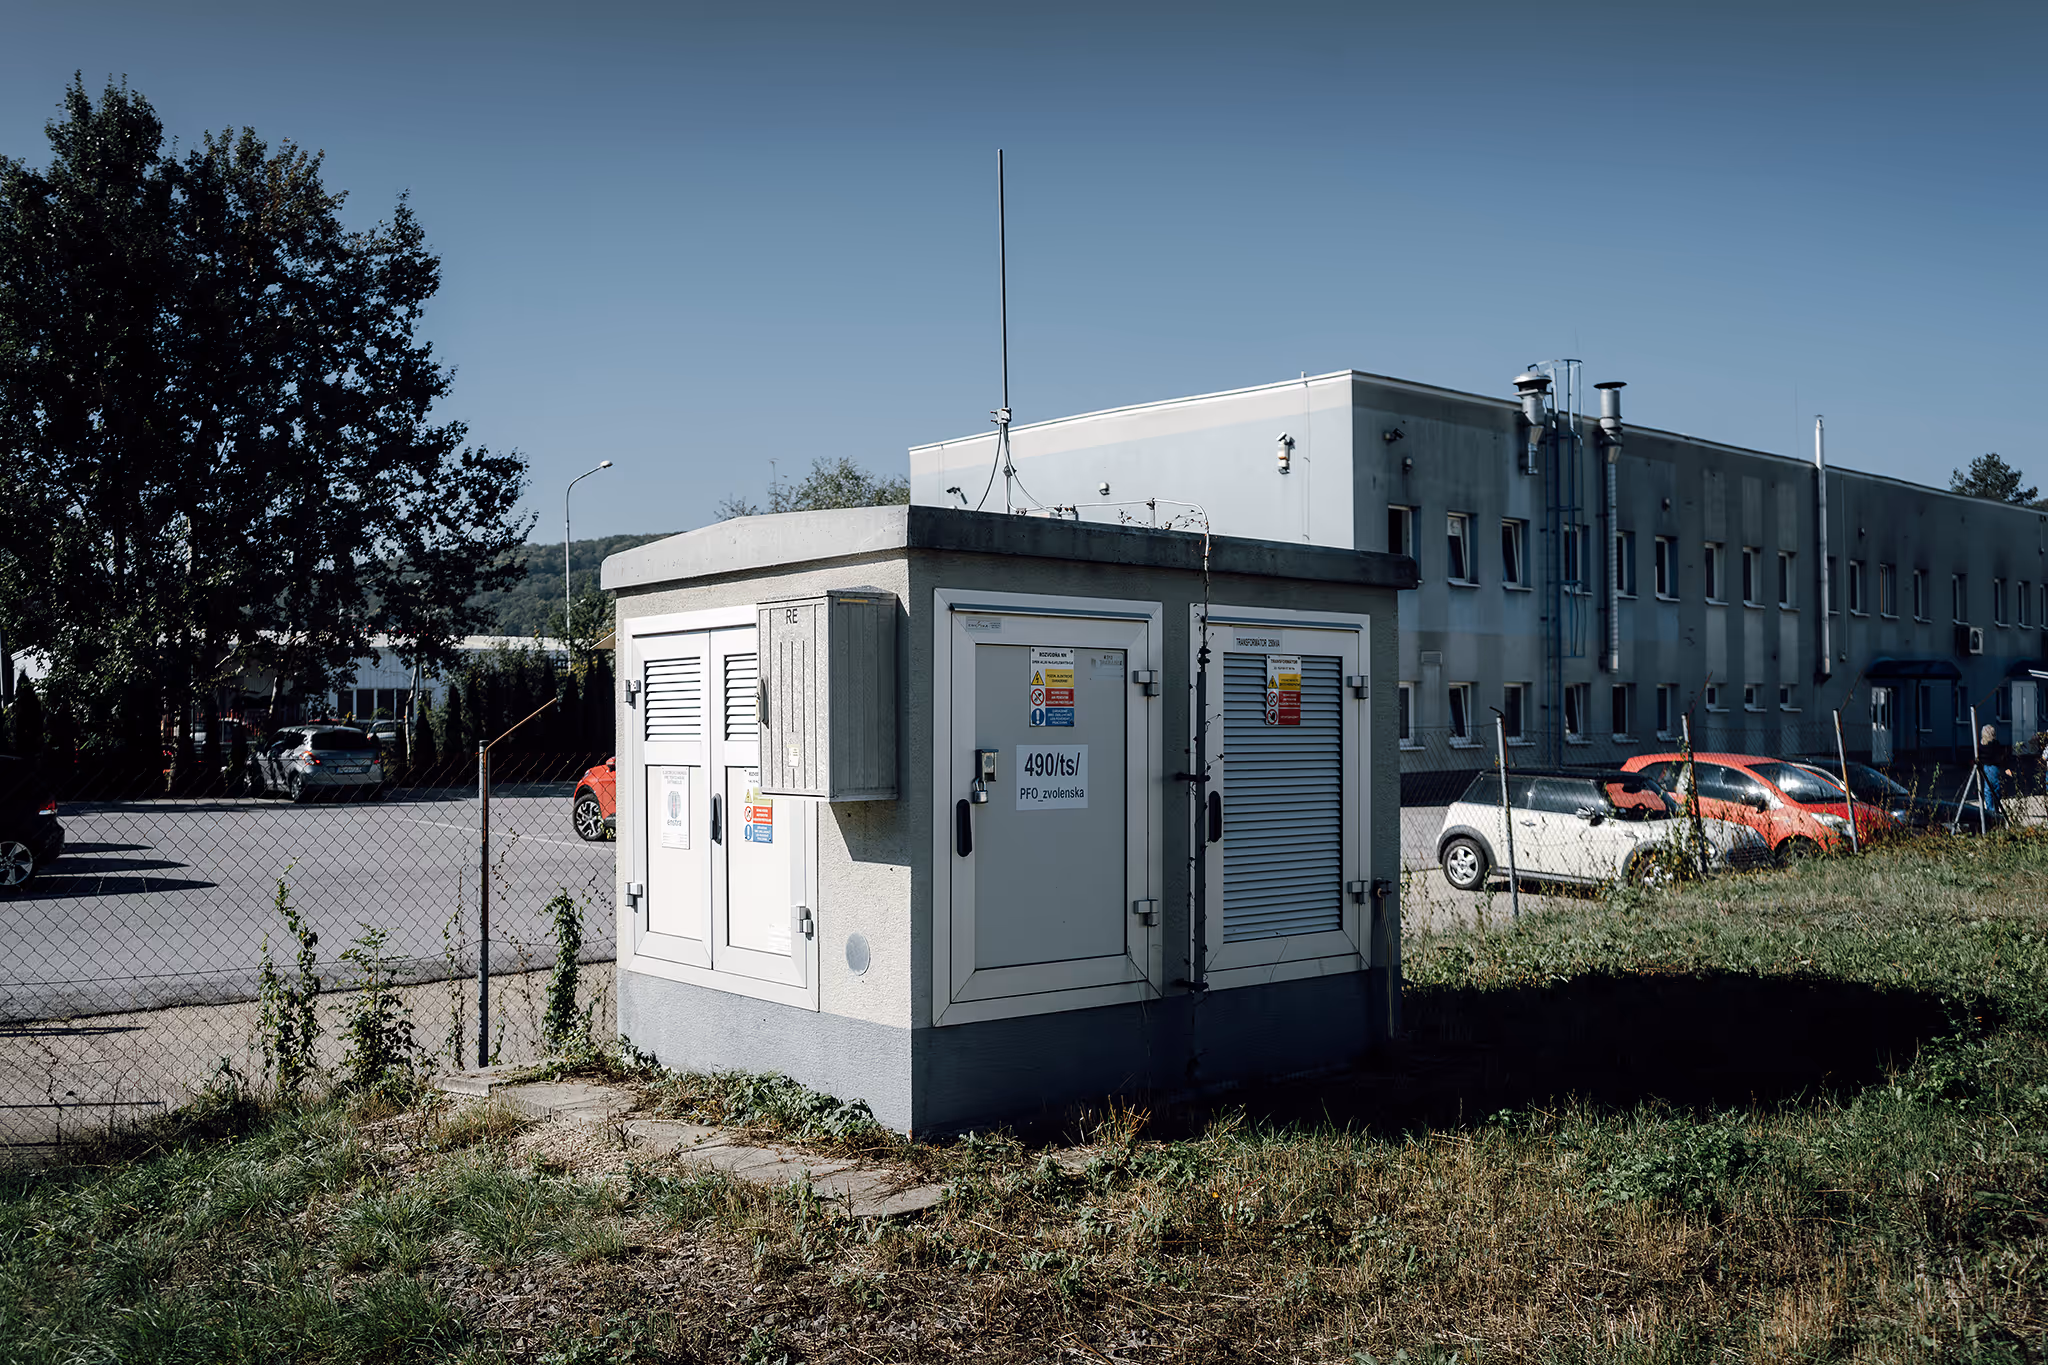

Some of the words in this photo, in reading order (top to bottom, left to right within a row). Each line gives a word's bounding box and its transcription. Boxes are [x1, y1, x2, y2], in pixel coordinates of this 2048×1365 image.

[785, 608, 798, 625] RE
[1024, 752, 1081, 777] 490/ts/
[1020, 786, 1085, 802] PFO_zvolenska
